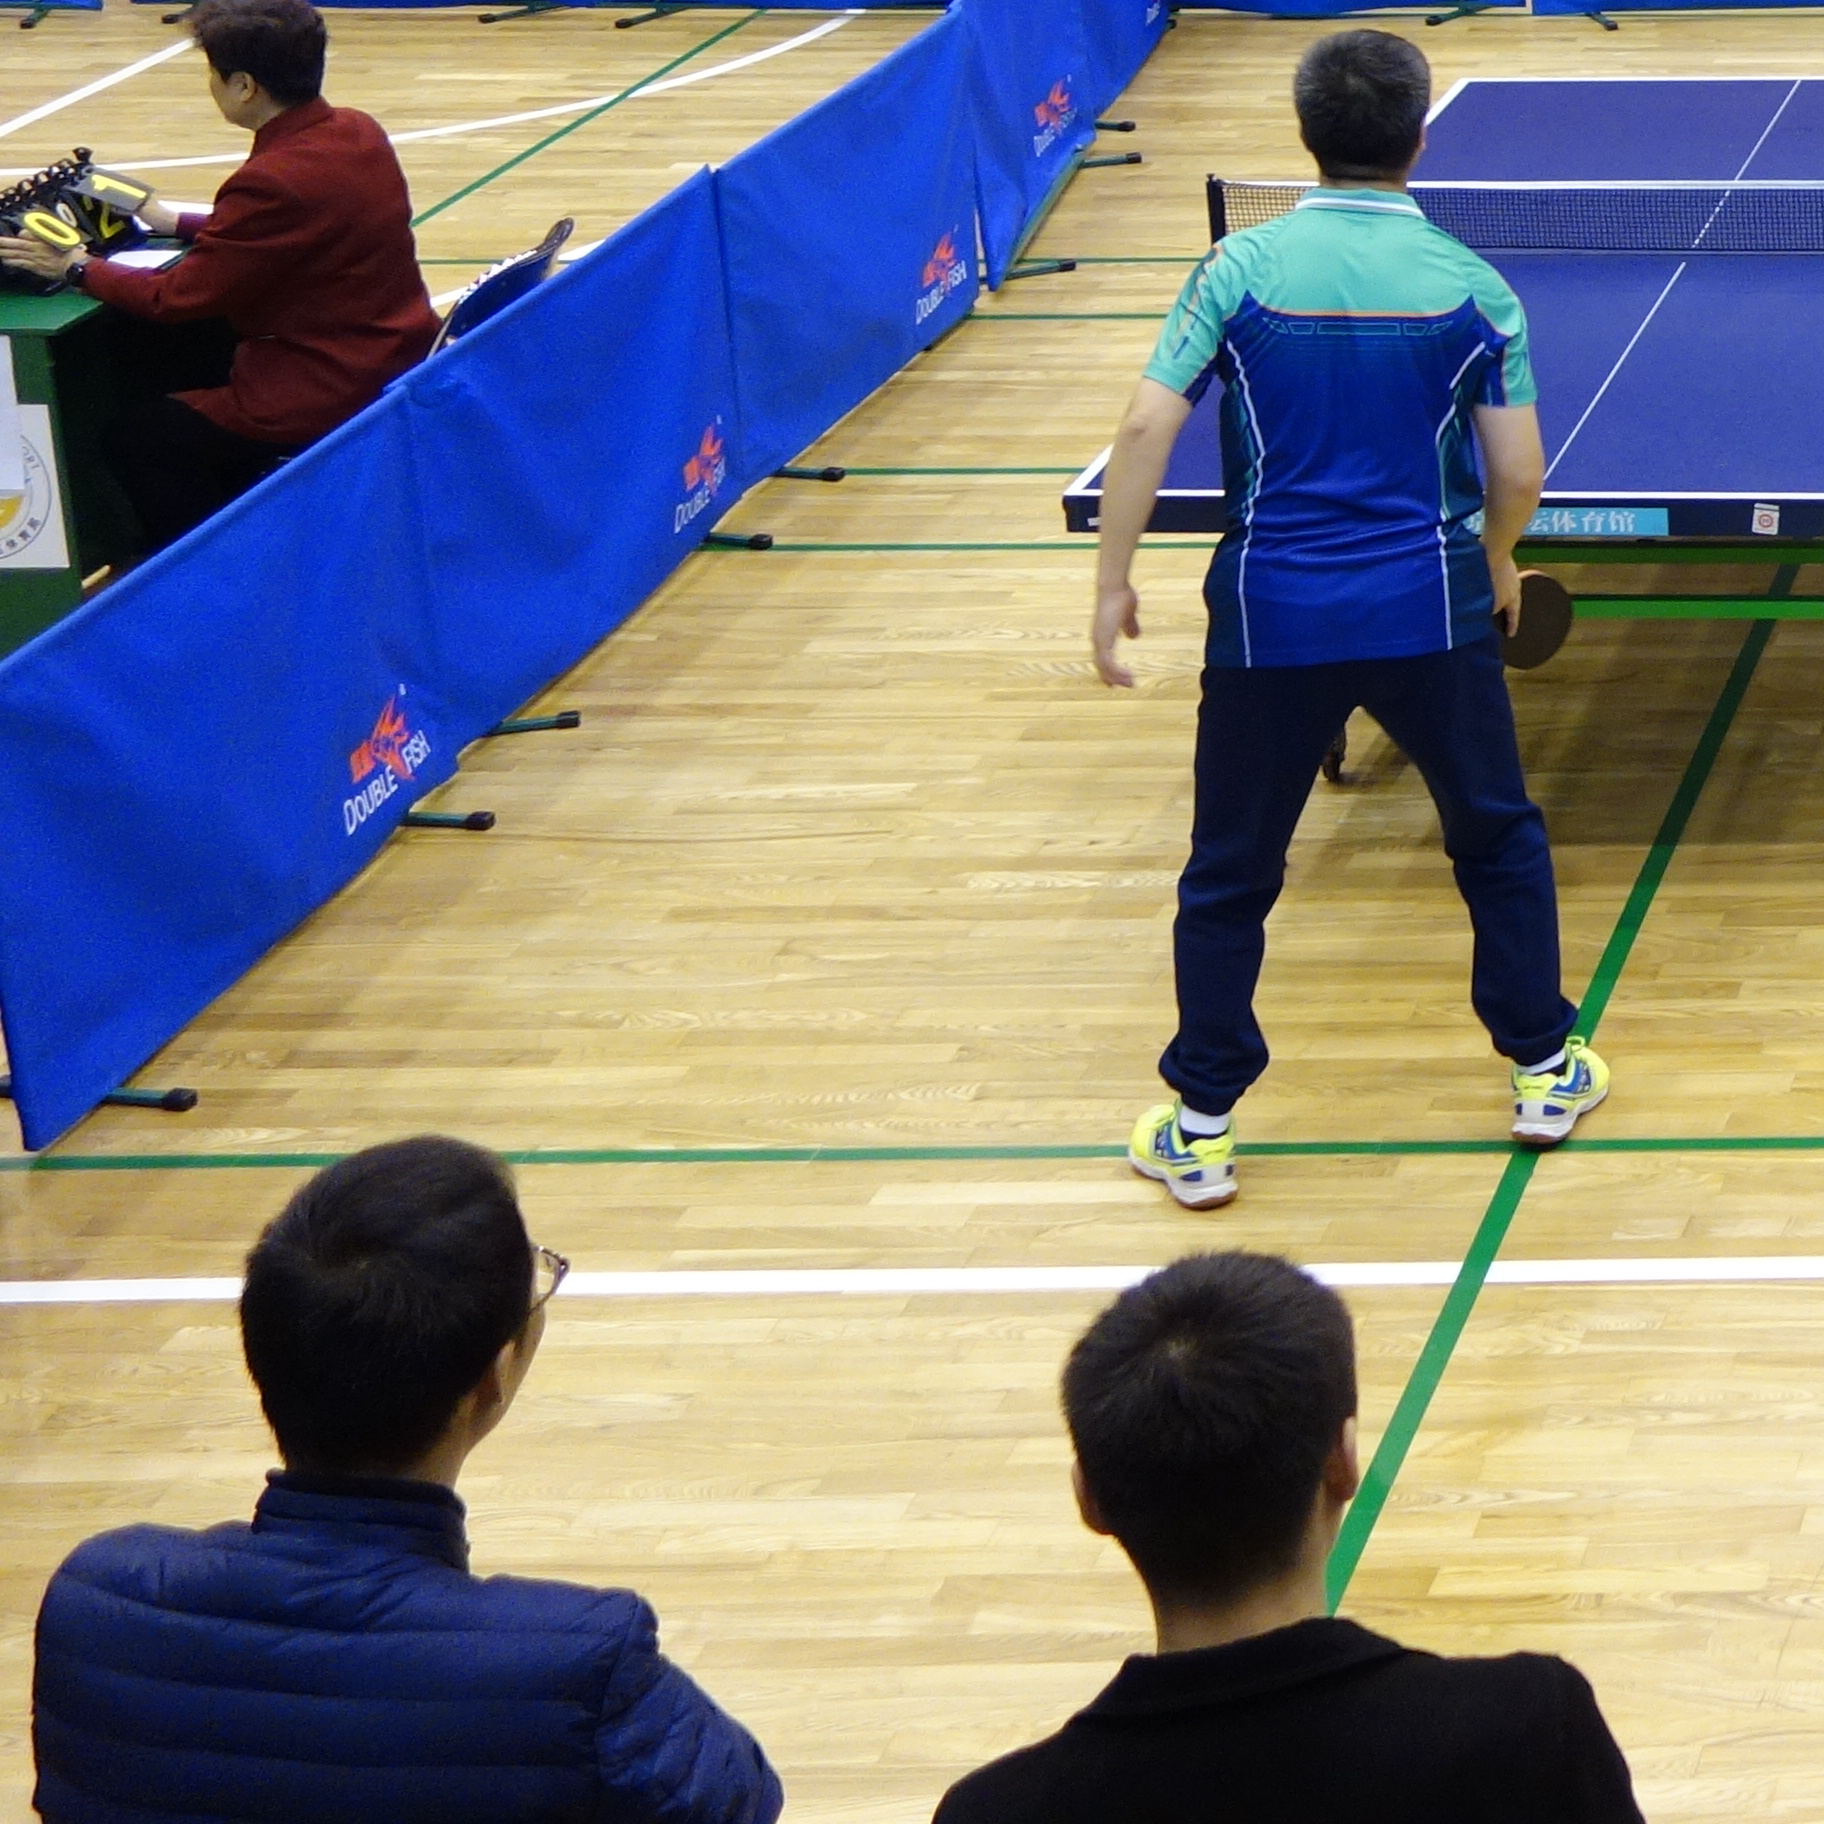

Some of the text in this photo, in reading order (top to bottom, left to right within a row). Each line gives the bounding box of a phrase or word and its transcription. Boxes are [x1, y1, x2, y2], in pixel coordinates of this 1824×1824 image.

[674, 480, 711, 535] DOUBLE
[342, 770, 398, 837] DOUBLE
[404, 729, 433, 776] FISH
